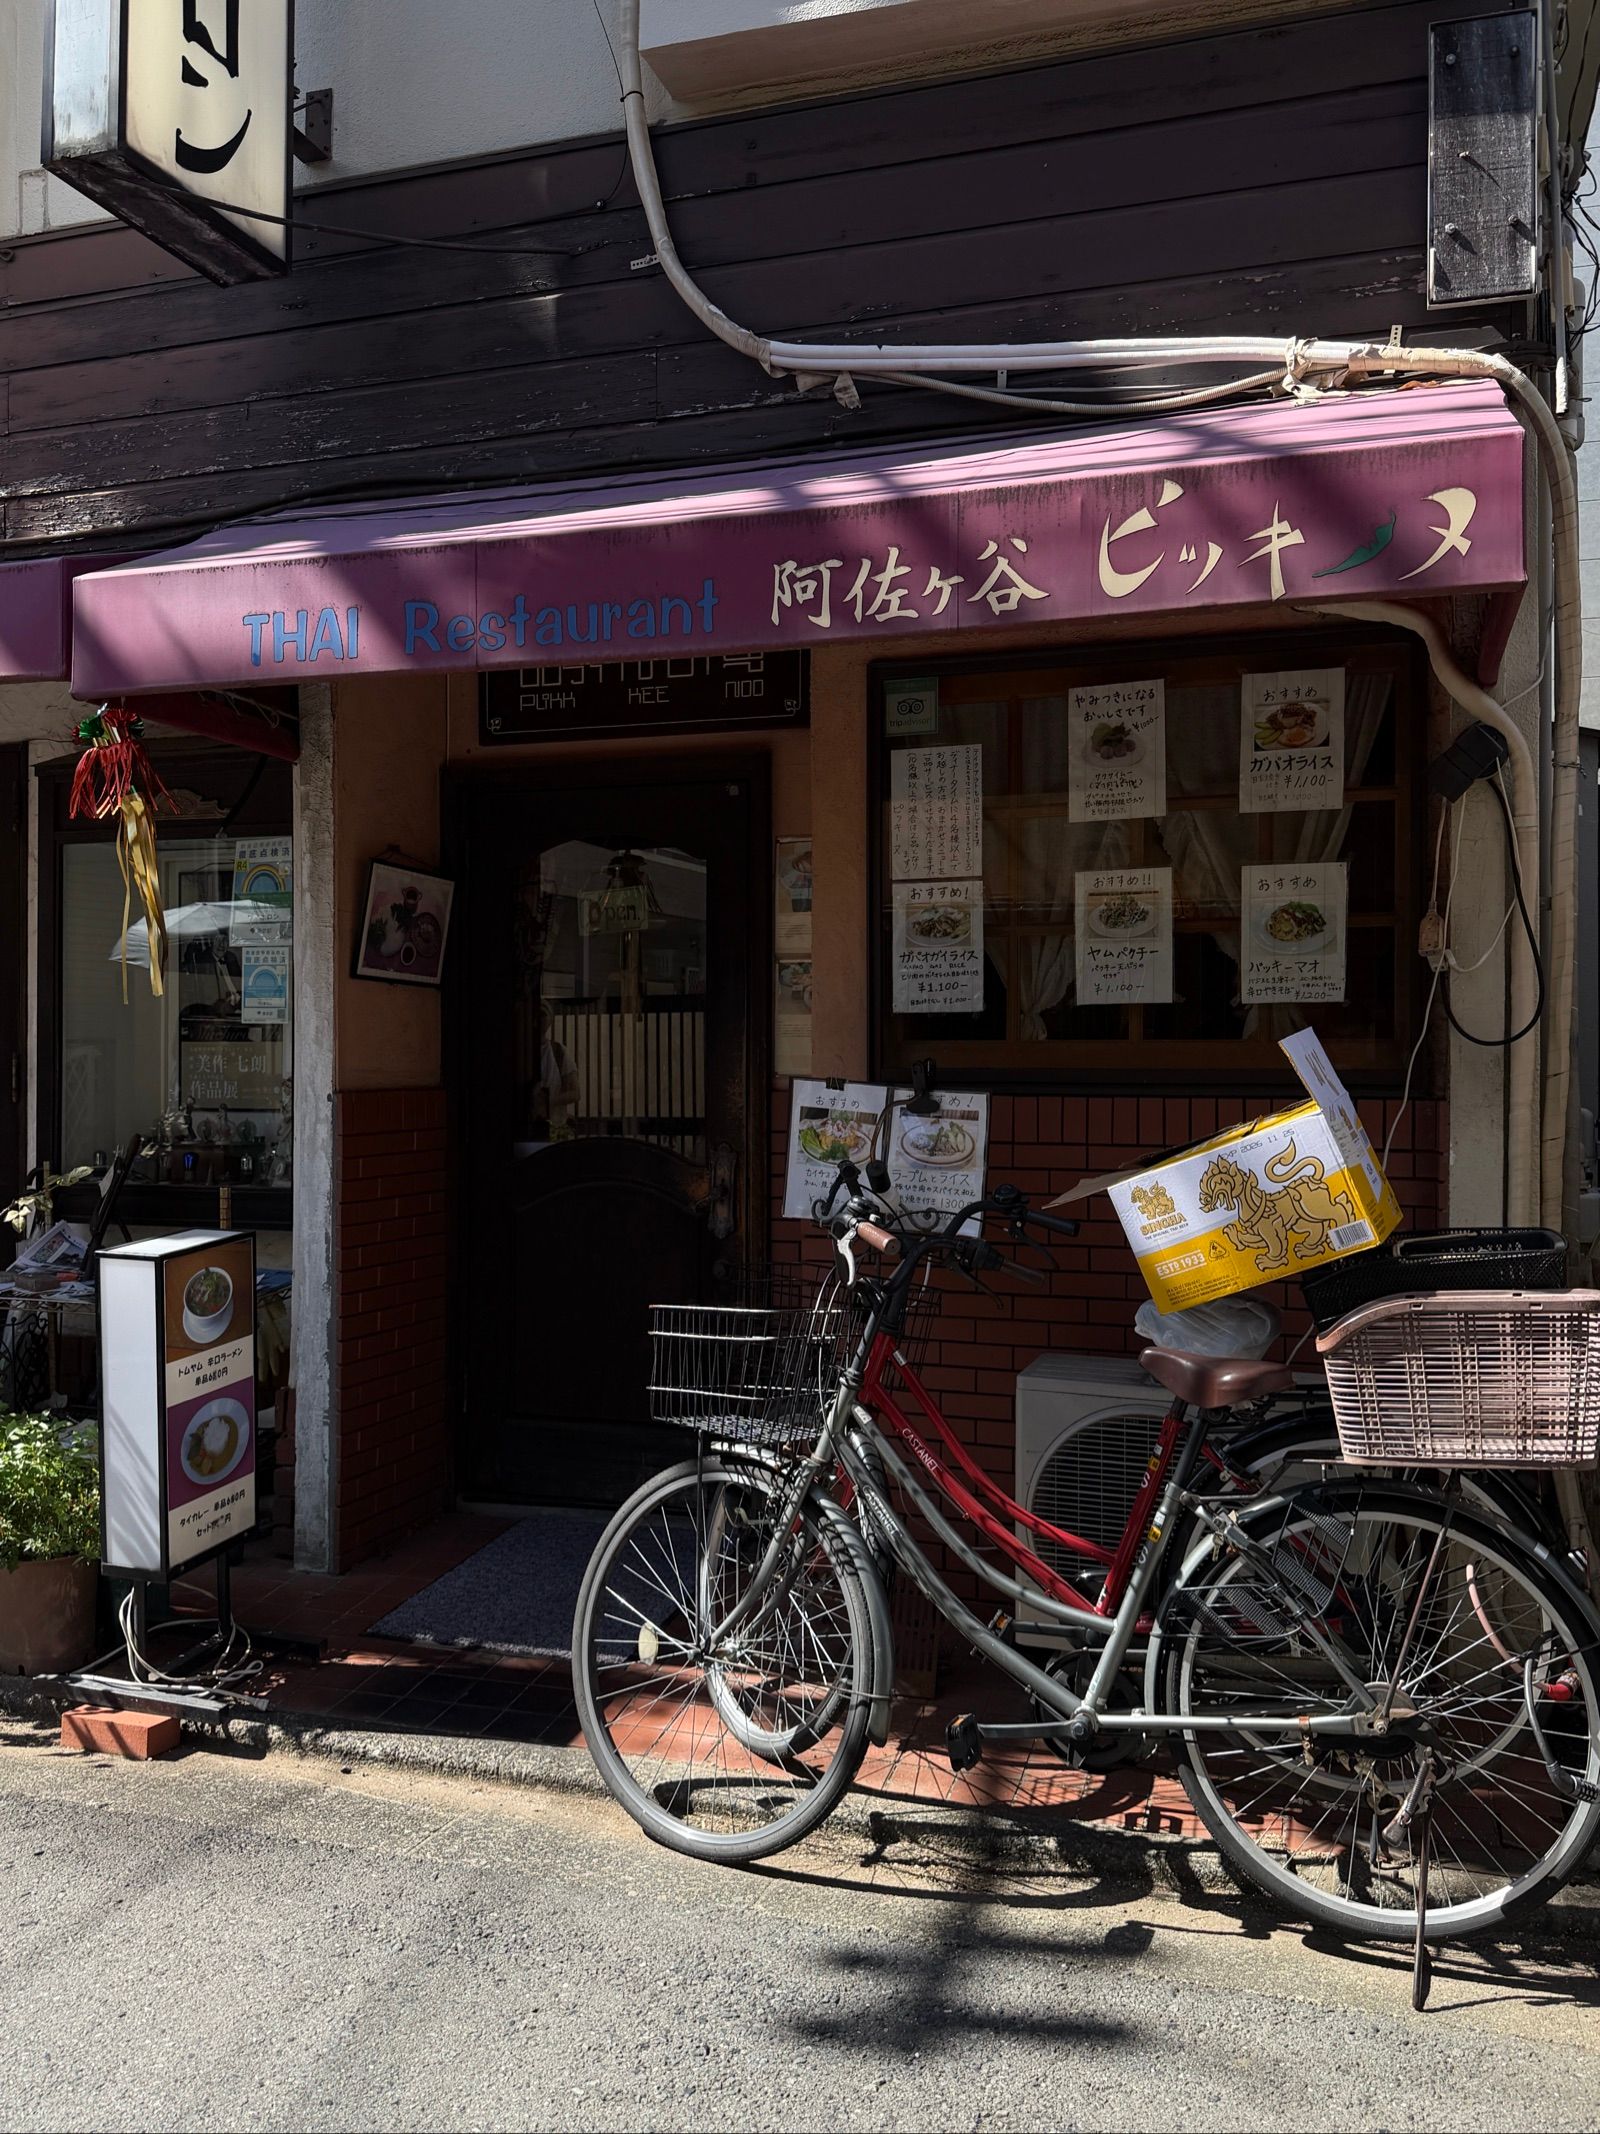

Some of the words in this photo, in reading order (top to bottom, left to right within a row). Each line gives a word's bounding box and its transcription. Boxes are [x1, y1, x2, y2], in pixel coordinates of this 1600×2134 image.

[771, 538, 1052, 628] 阿佐ヶ谷
[242, 607, 360, 666] THAI
[404, 580, 719, 655] Restaurant
[628, 685, 670, 704] KEE
[1075, 688, 1155, 708] やみつきになる
[1263, 686, 1318, 702] おすすめ
[1083, 705, 1146, 722] おいしさです
[1250, 755, 1334, 773] ガパオライス
[1257, 875, 1318, 892] おすすめ
[899, 950, 979, 963] ガパオガイライス
[1087, 946, 1159, 961] ヤムパクチー
[1248, 960, 1320, 974] パッキーマオ
[191, 1080, 239, 1099] 作品展
[815, 1096, 860, 1109] おすすめ
[1141, 1213, 1187, 1236] SINGHA
[1181, 1252, 1206, 1269] 1933
[178, 1362, 203, 1378] トムヤム
[208, 1347, 243, 1366] 辛口ラーメン
[902, 1427, 943, 1478] CASTANET
[180, 1510, 209, 1528] タイカレー
